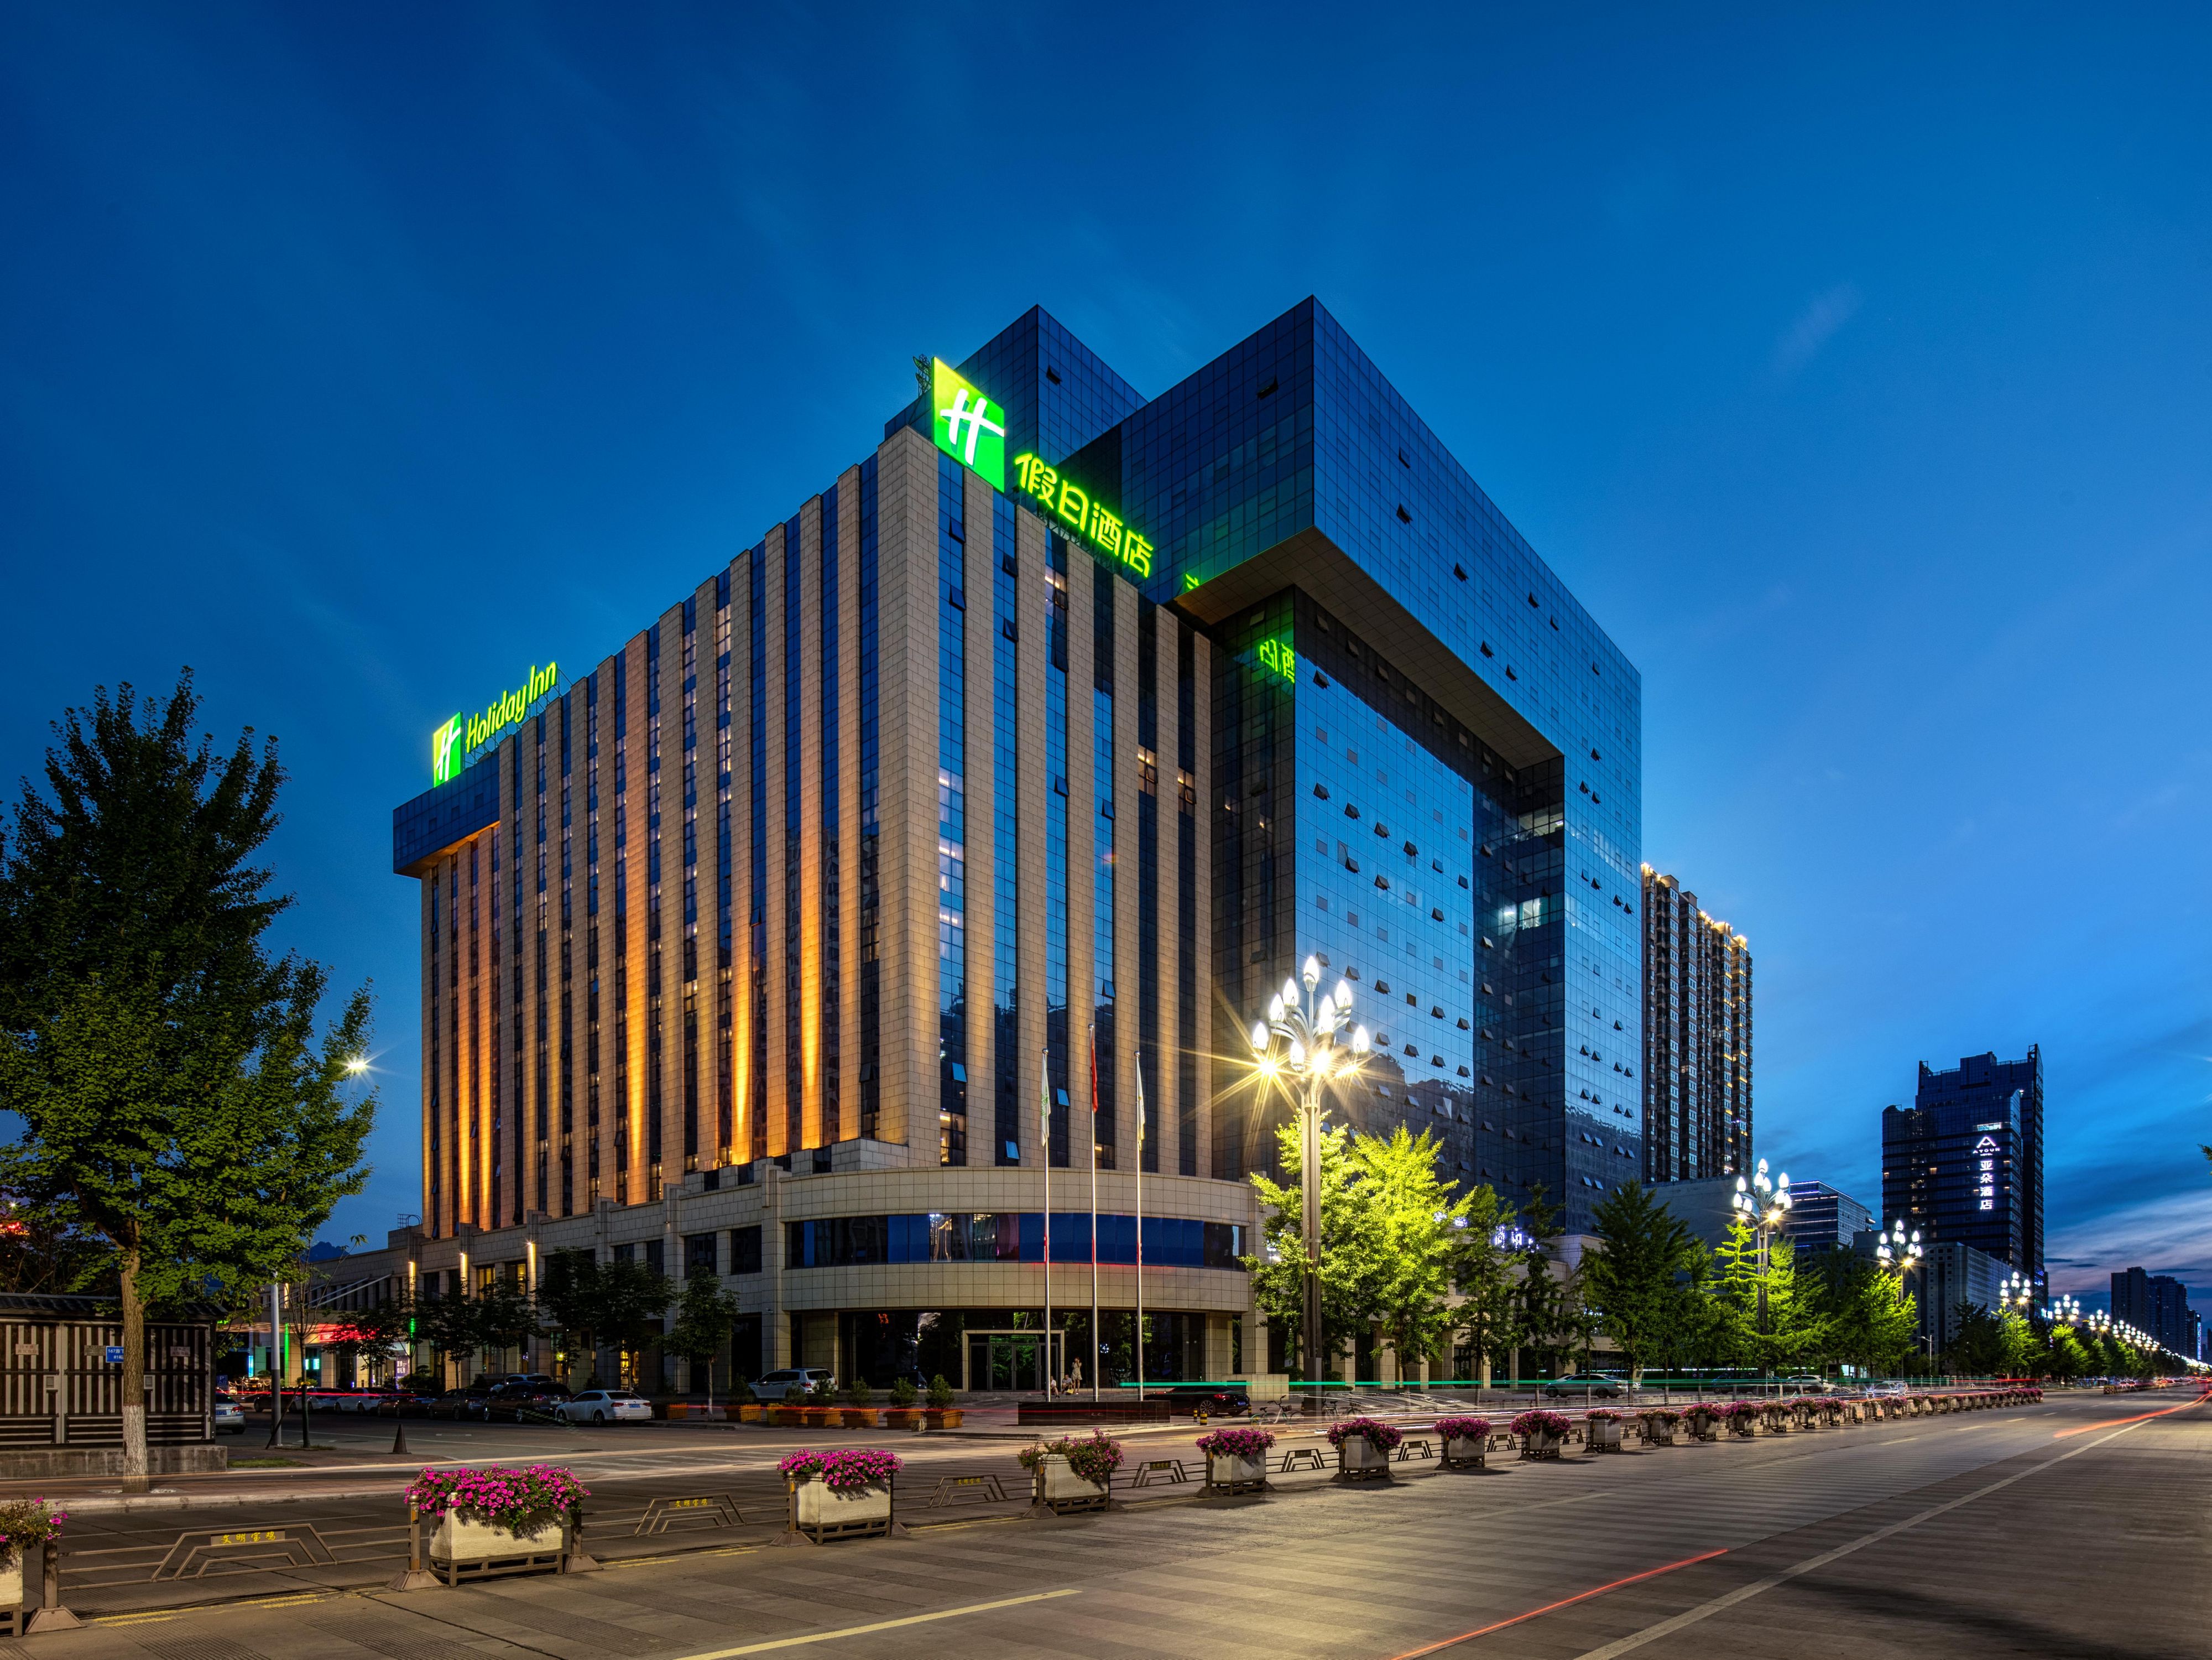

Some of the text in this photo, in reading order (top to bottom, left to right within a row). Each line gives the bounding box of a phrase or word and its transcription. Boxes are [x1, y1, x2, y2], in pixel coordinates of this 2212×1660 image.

[1014, 453, 1154, 577] 假日酒店
[466, 662, 556, 753] Holiday Inn
[1980, 1160, 1994, 1210] 亚朵酒店
[221, 1531, 275, 1544] 文明宝鸡
